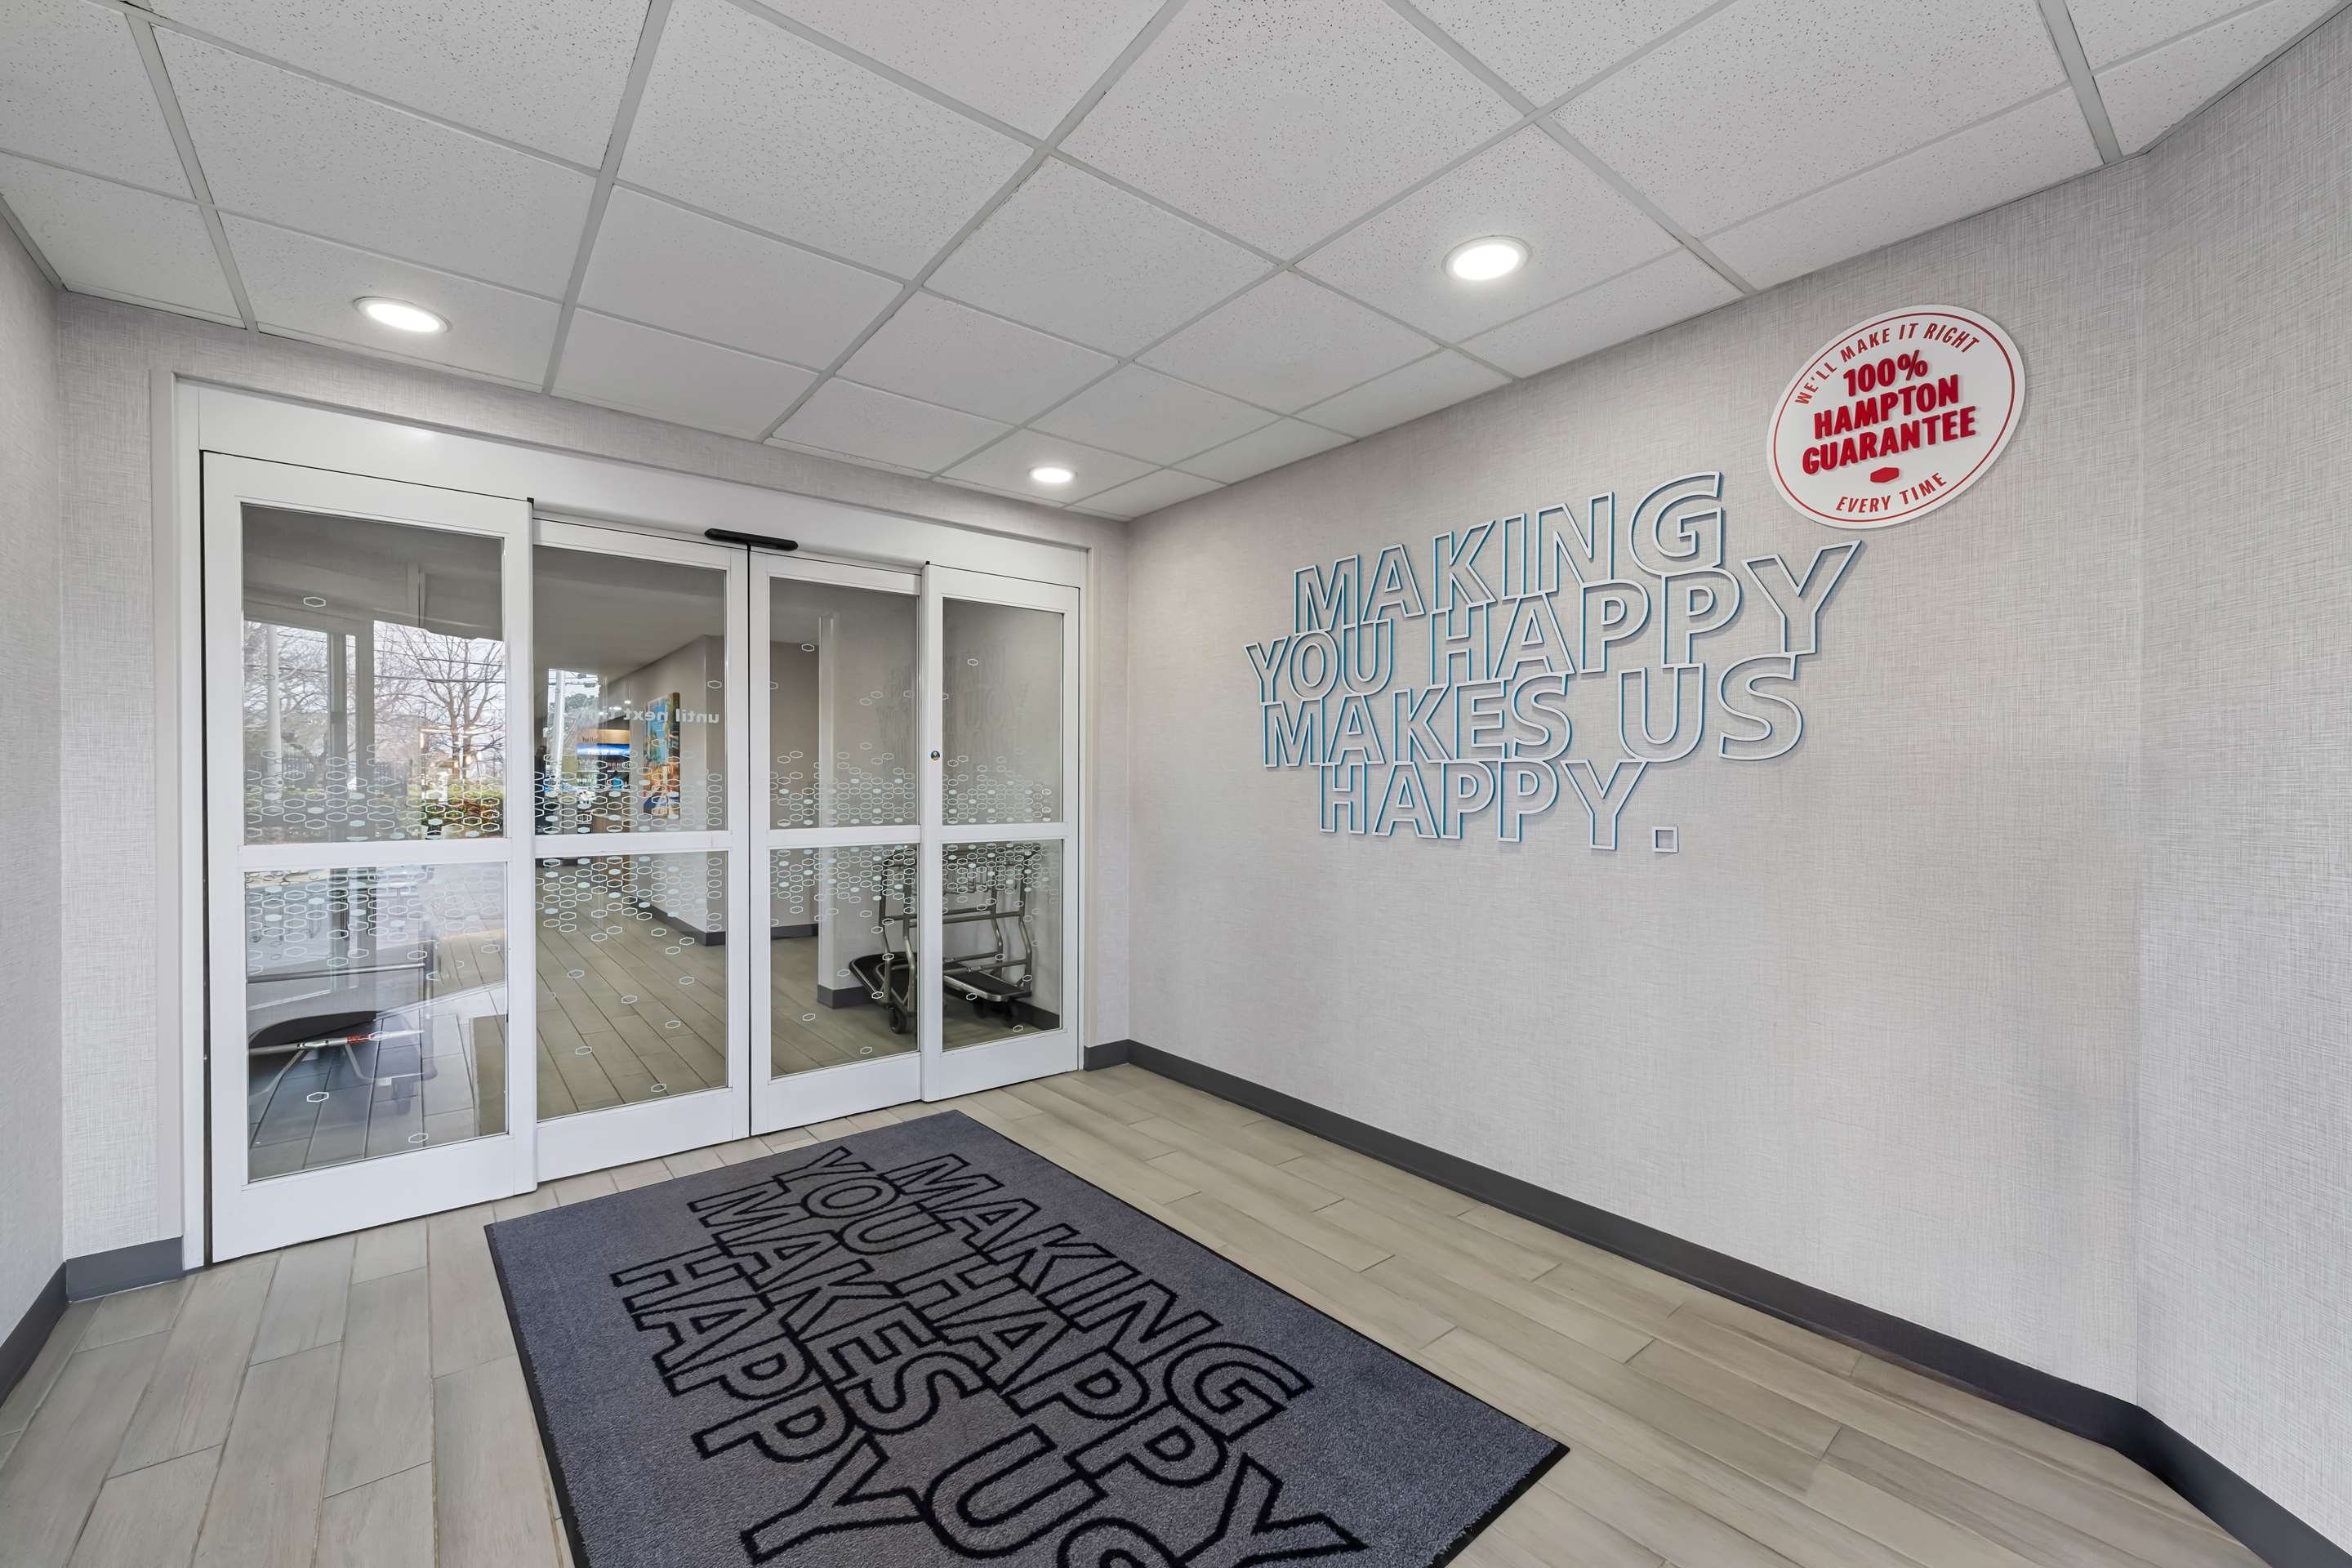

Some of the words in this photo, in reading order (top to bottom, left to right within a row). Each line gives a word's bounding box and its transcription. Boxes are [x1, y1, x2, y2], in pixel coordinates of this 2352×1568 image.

[1795, 362, 1838, 405] WE'LL
[1841, 327, 1891, 363] MAKE
[1899, 323, 1918, 340] IT
[1923, 323, 1980, 353] RIGHT
[1814, 374, 1959, 439] HAMPTON
[1843, 350, 1928, 397] 100%
[1802, 406, 1976, 474] GUARANTEE
[1836, 496, 1891, 513] EVERY
[1900, 473, 1947, 505] TIME
[1294, 471, 1725, 635] MAKING
[1245, 617, 1393, 706] YOU
[1429, 539, 1863, 687] HAPPY
[1263, 673, 1573, 768] MAKES
[1619, 654, 1803, 762] US
[1320, 758, 1680, 853] HAPPY.
[687, 1180, 988, 1436] MAKES
[878, 1153, 1315, 1443] MAKING
[610, 1243, 931, 1566] HAPPY
[772, 1146, 955, 1255] YOU
[894, 1251, 1370, 1568] HAPPY
